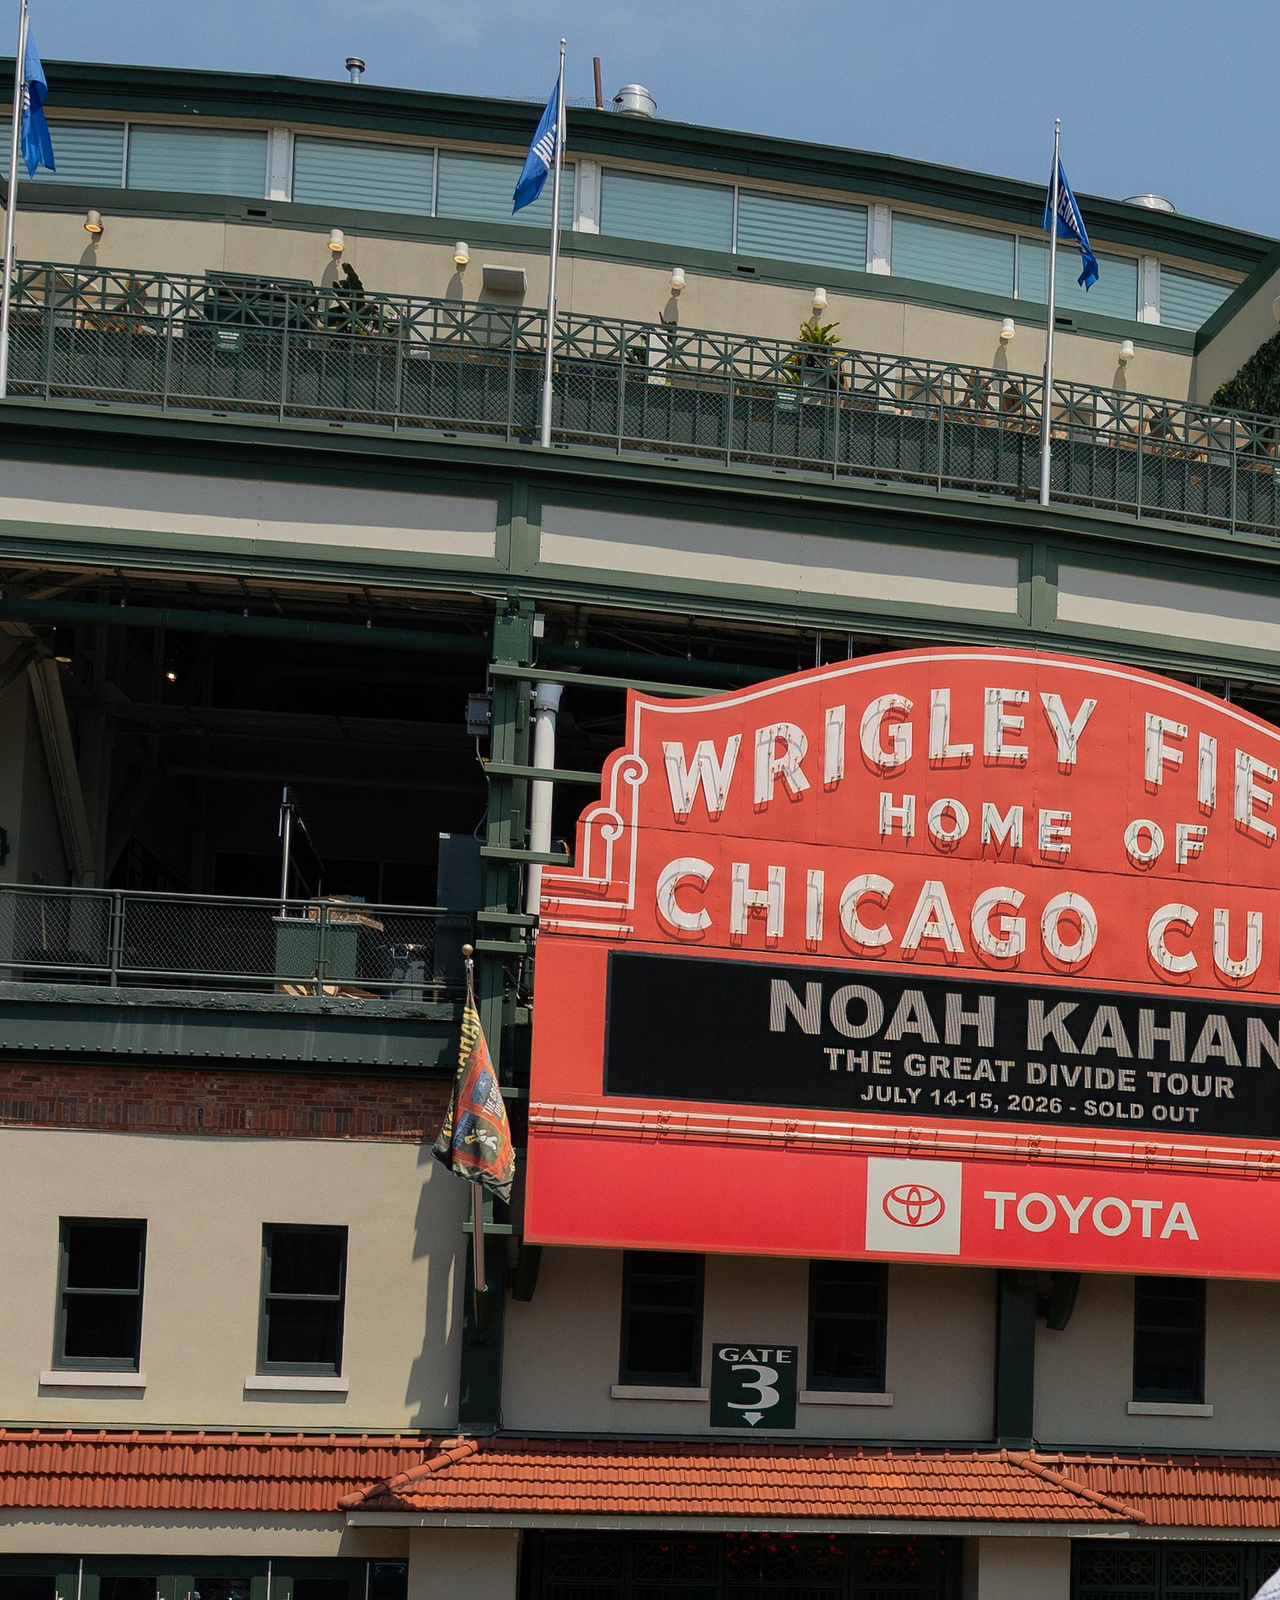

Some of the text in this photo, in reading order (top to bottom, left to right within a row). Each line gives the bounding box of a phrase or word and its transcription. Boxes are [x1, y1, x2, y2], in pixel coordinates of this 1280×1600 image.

[662, 687, 1098, 815] WRIGLEY
[879, 792, 1208, 865] HOME OF
[656, 857, 1099, 963] CHICAGO
[770, 979, 996, 1047] NOAH
[824, 1047, 1235, 1099] THE GREAT DIVIDE TOUR
[860, 1085, 922, 1104] JULY
[930, 1089, 999, 1113] 14-15,
[1007, 1094, 1063, 1114] 2026
[1083, 1100, 1145, 1120] SOLD
[1152, 1105, 1199, 1124] OUT
[983, 1190, 1200, 1241] TOYOTA
[719, 1348, 791, 1363] GATE
[727, 1364, 780, 1410] 3
